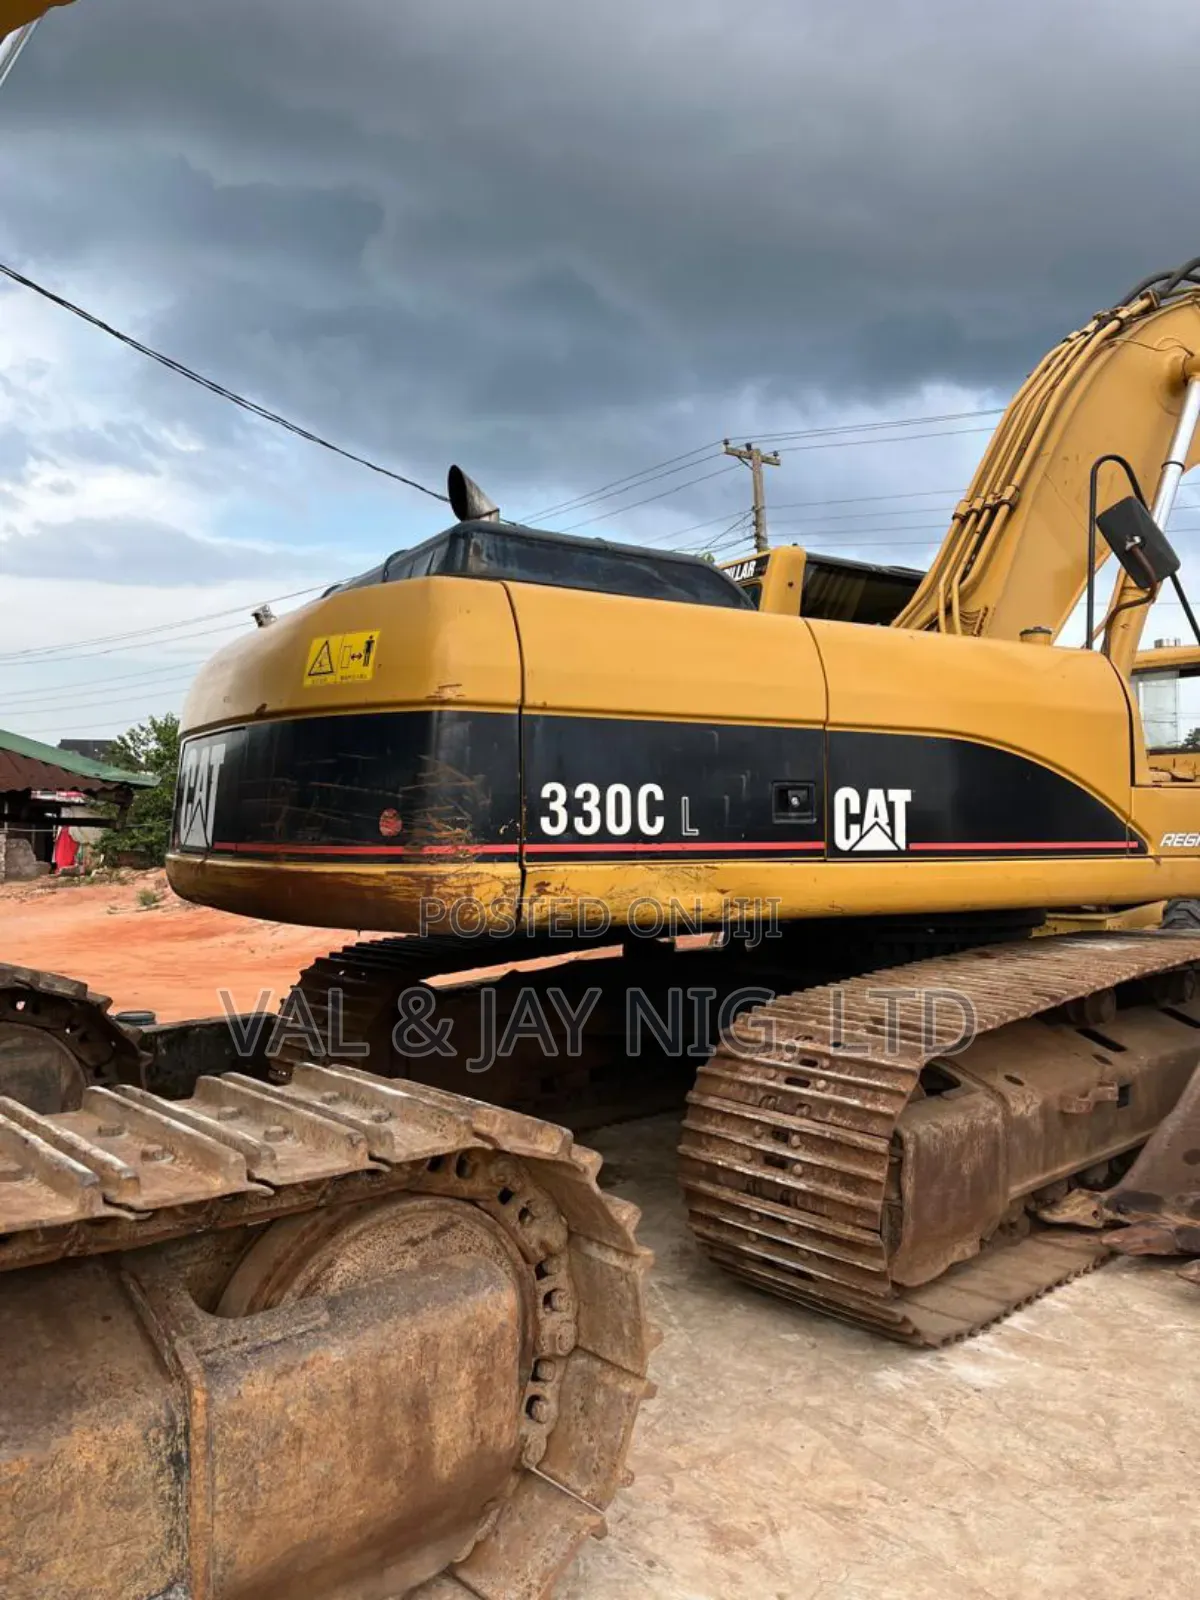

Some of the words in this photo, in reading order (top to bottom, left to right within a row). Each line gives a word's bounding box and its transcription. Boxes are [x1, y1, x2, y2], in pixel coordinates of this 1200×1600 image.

[180, 743, 226, 848] CAT
[540, 782, 665, 836] 330C
[681, 796, 699, 836] L
[834, 786, 912, 852] CAT
